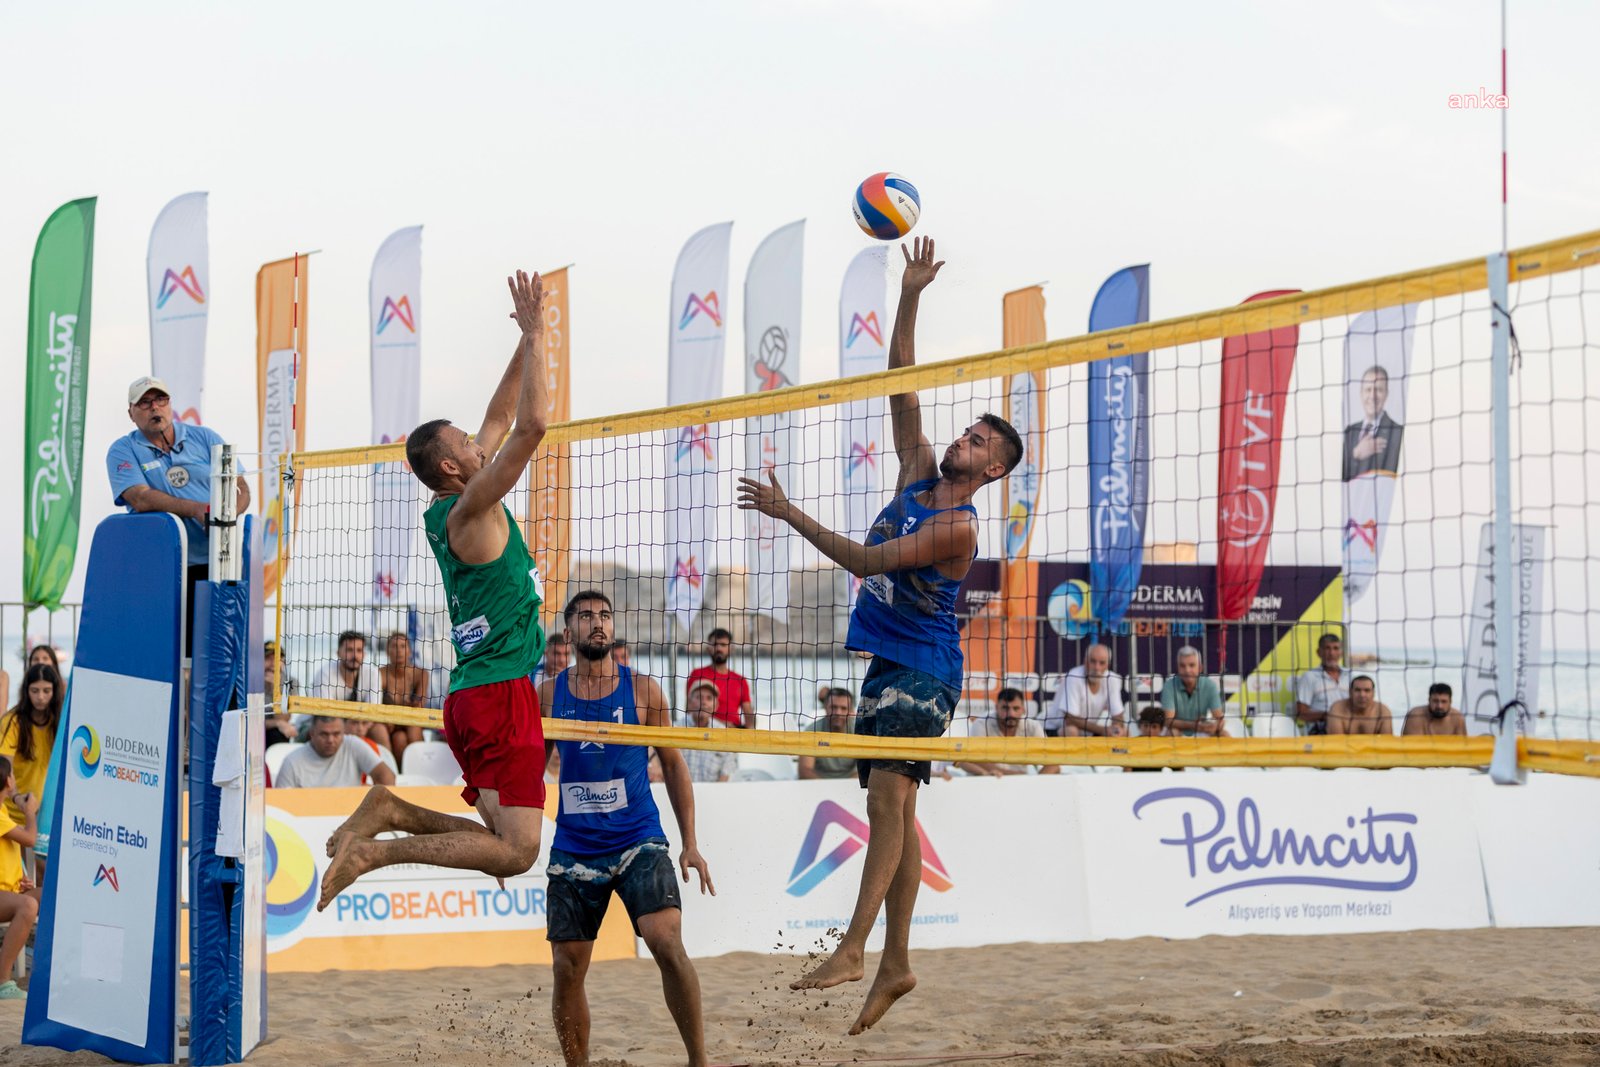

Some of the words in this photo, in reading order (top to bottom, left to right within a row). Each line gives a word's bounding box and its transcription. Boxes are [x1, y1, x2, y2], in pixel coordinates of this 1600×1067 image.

[1238, 390, 1273, 477] TVF
[1095, 364, 1140, 562] Palmcity
[1131, 585, 1204, 603] DERMA
[612, 706, 624, 724] 1
[105, 735, 160, 759] BIODERMA
[103, 764, 158, 788] PROBEACHTOUR
[568, 785, 618, 807] Palmcity
[73, 815, 114, 841] Mersin
[116, 825, 148, 849] Etabı
[72, 838, 108, 854] presented
[108, 846, 119, 857] by
[1133, 787, 1418, 907] Palmcity
[336, 888, 546, 922] PROBEACHTOUR
[1228, 903, 1281, 921] Alışveriş
[1284, 907, 1299, 918] ve
[1301, 903, 1342, 919] Yaşam
[1346, 901, 1392, 917] Merkezi
